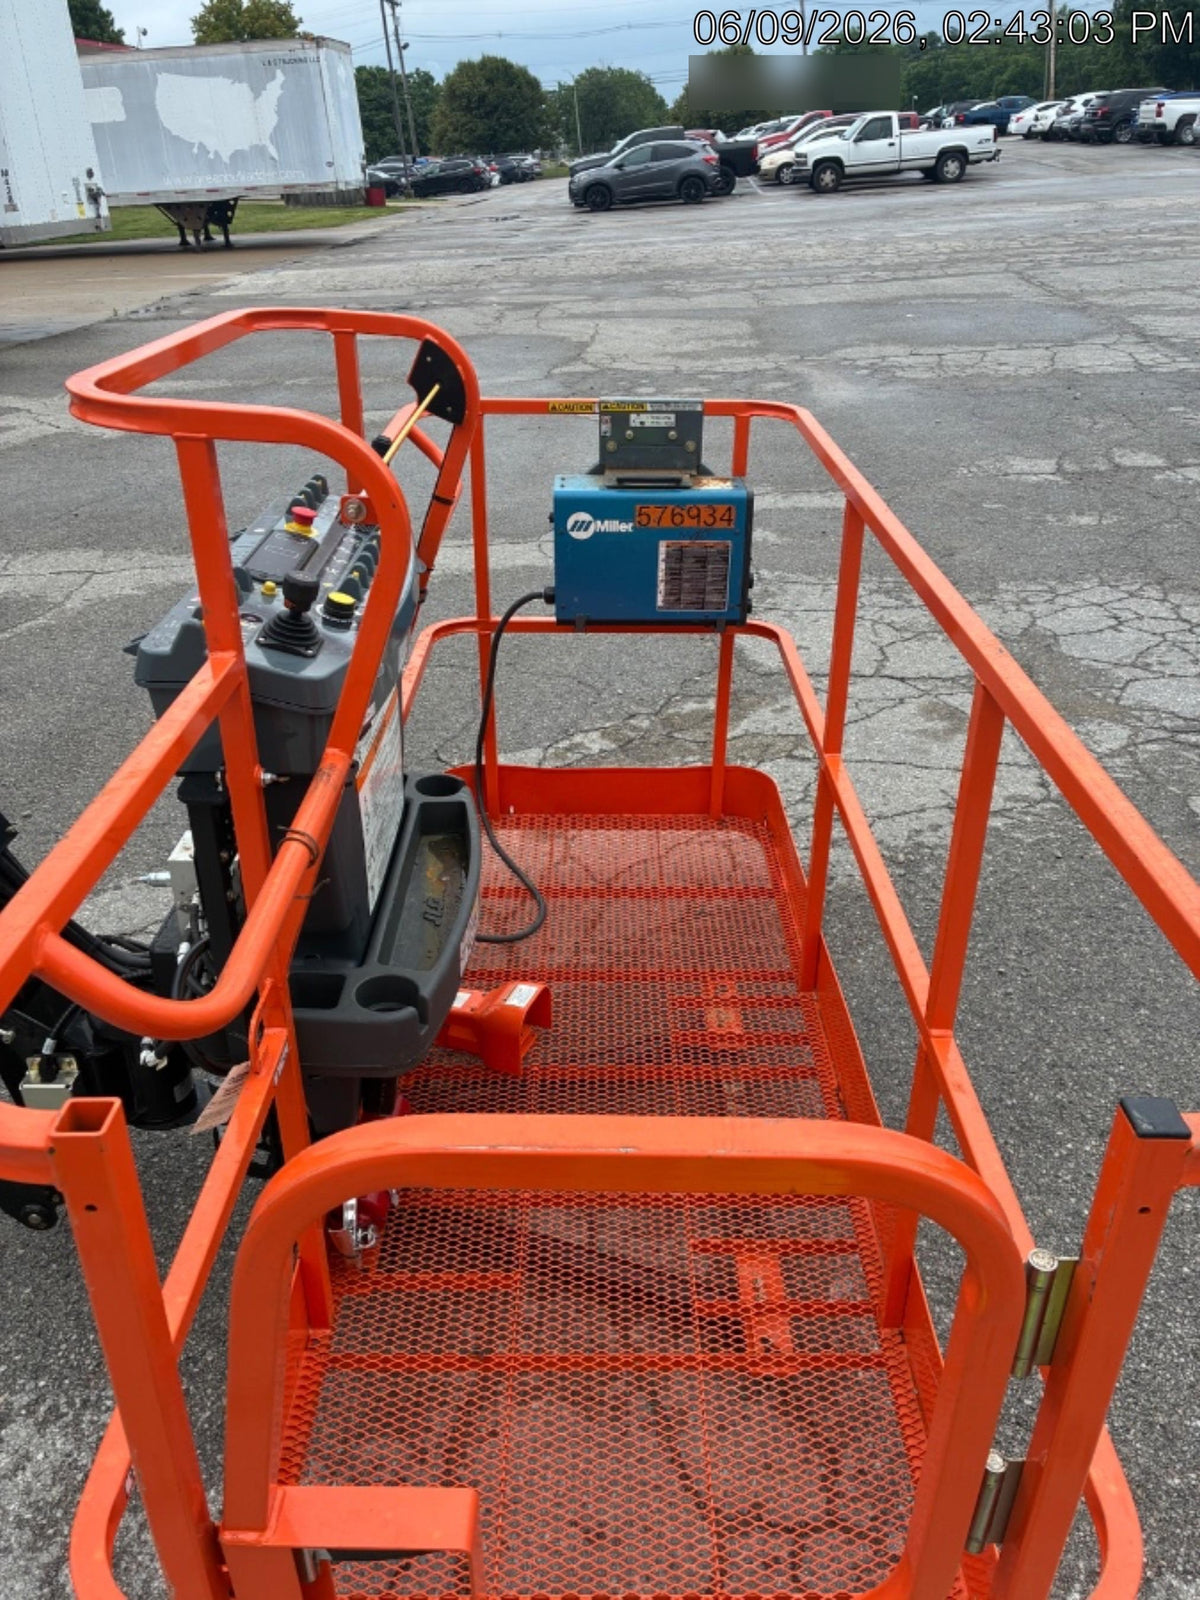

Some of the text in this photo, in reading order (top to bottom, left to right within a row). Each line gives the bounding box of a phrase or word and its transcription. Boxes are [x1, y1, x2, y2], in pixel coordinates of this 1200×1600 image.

[558, 403, 594, 412] CAUTION
[608, 402, 645, 411] CAUTION
[637, 505, 735, 527] 576934
[595, 519, 634, 533] Miller
